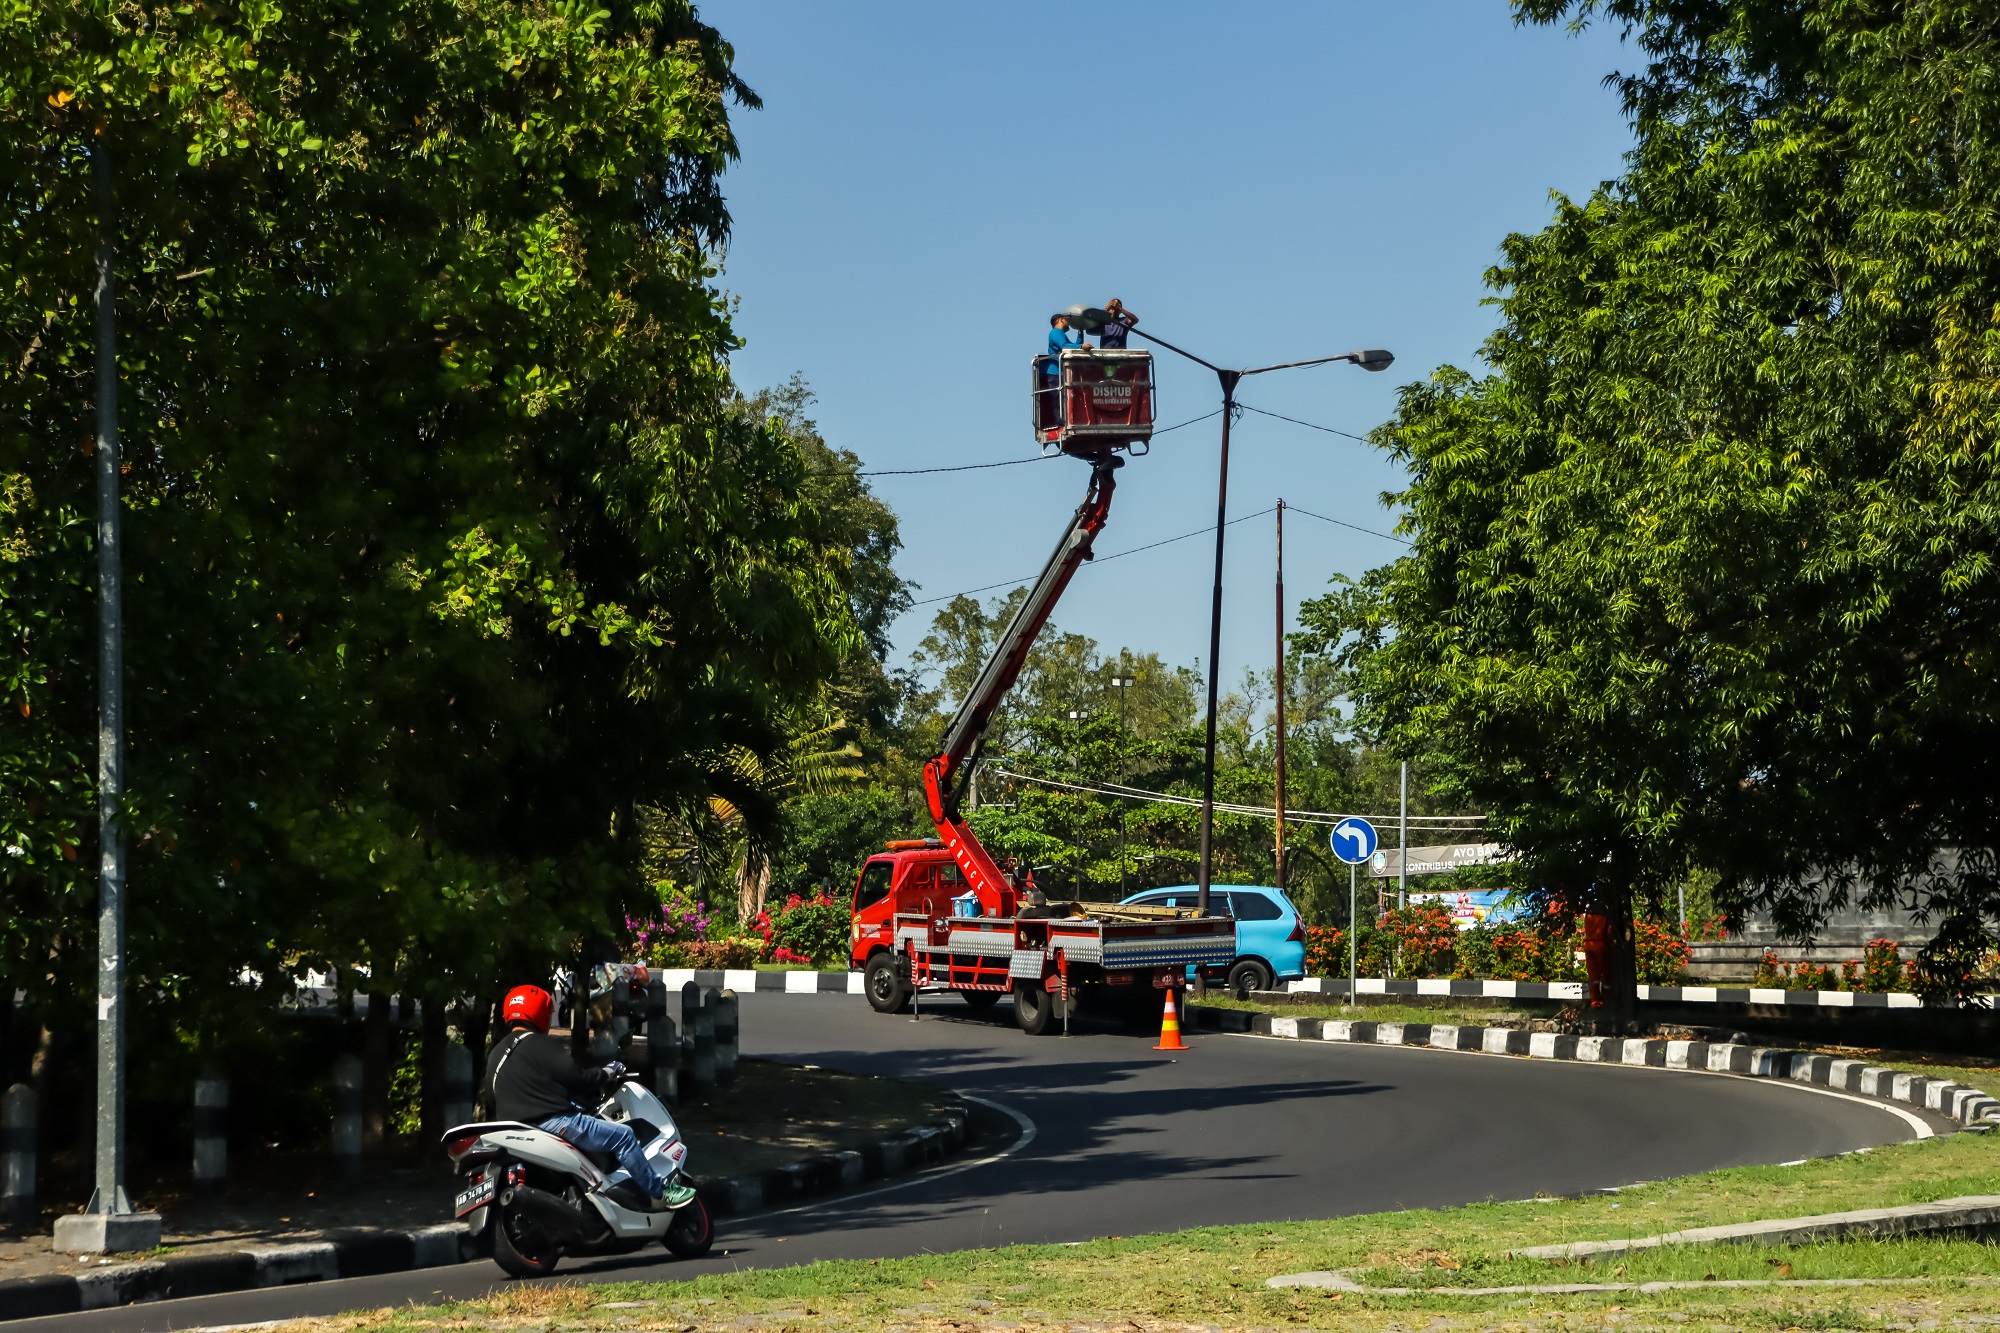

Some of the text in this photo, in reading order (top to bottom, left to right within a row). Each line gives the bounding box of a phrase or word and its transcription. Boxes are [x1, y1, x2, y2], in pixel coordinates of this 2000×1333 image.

[1093, 386, 1131, 397] DISHUB
[1453, 847, 1475, 858] AYO
[950, 839, 984, 890] GRACE
